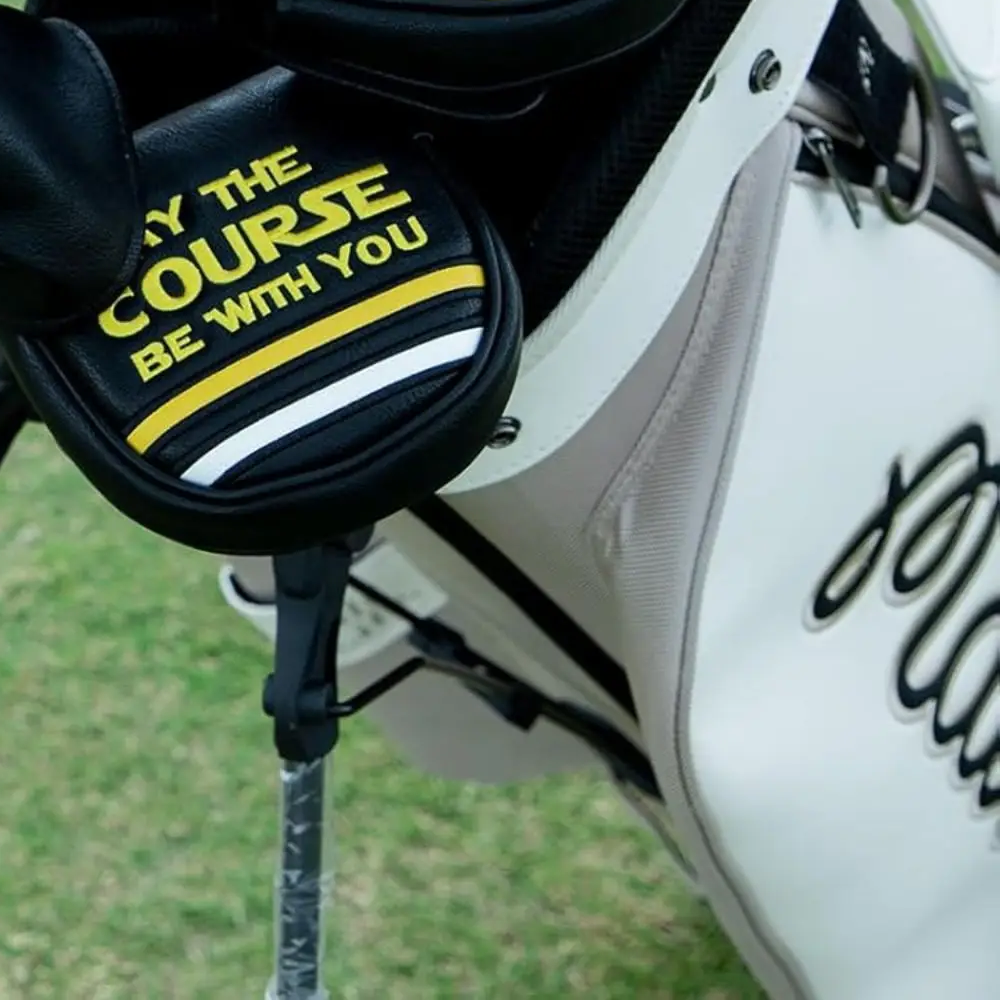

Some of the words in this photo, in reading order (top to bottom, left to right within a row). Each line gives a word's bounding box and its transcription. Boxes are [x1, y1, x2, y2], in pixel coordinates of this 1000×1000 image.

[98, 163, 412, 338] COURSE
[199, 144, 312, 211] THE
[130, 324, 206, 383] BE
[202, 264, 321, 334] WITH
[317, 215, 429, 279] YOU
